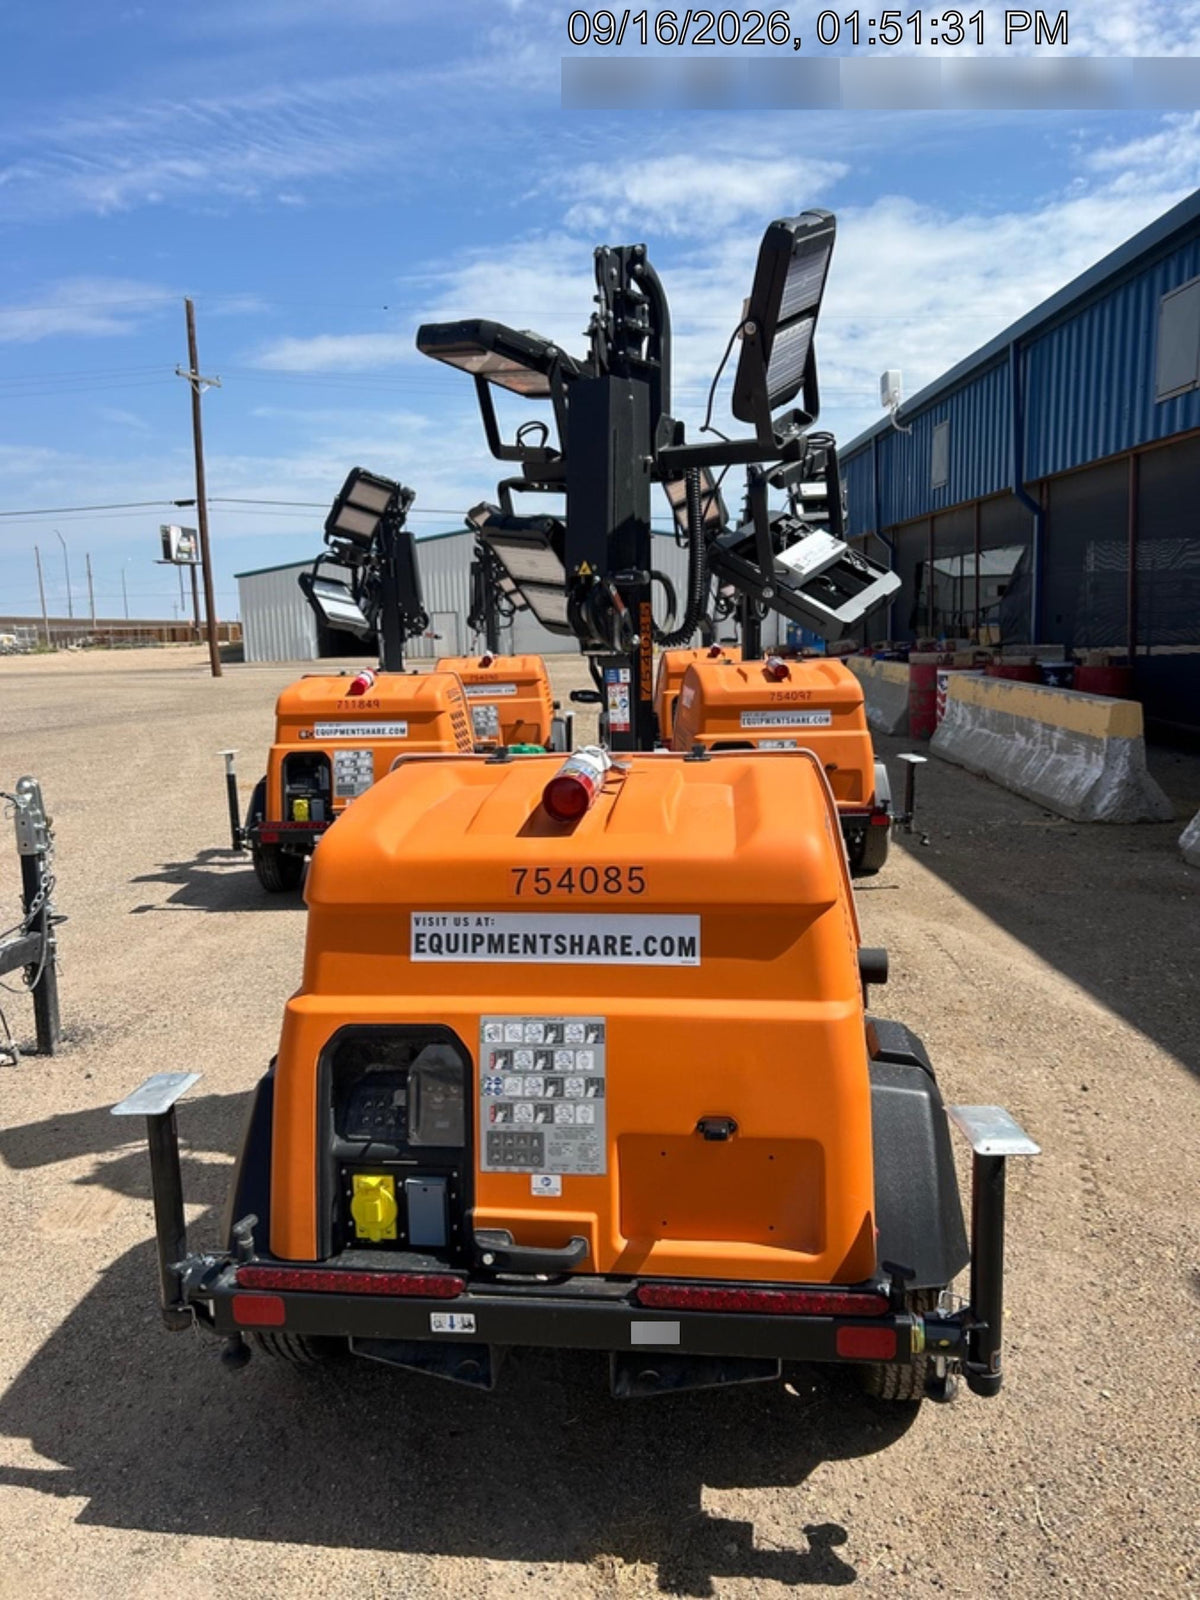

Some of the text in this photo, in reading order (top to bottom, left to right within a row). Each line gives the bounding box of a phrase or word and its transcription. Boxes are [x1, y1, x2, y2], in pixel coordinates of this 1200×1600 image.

[336, 699, 380, 710] 711849
[315, 726, 406, 737] EQUIPMENTSHARE.COM
[510, 865, 646, 896] 754085
[413, 916, 496, 928] VISIT US AT:
[413, 932, 697, 958] EQUIPMENTSHARE.COM
